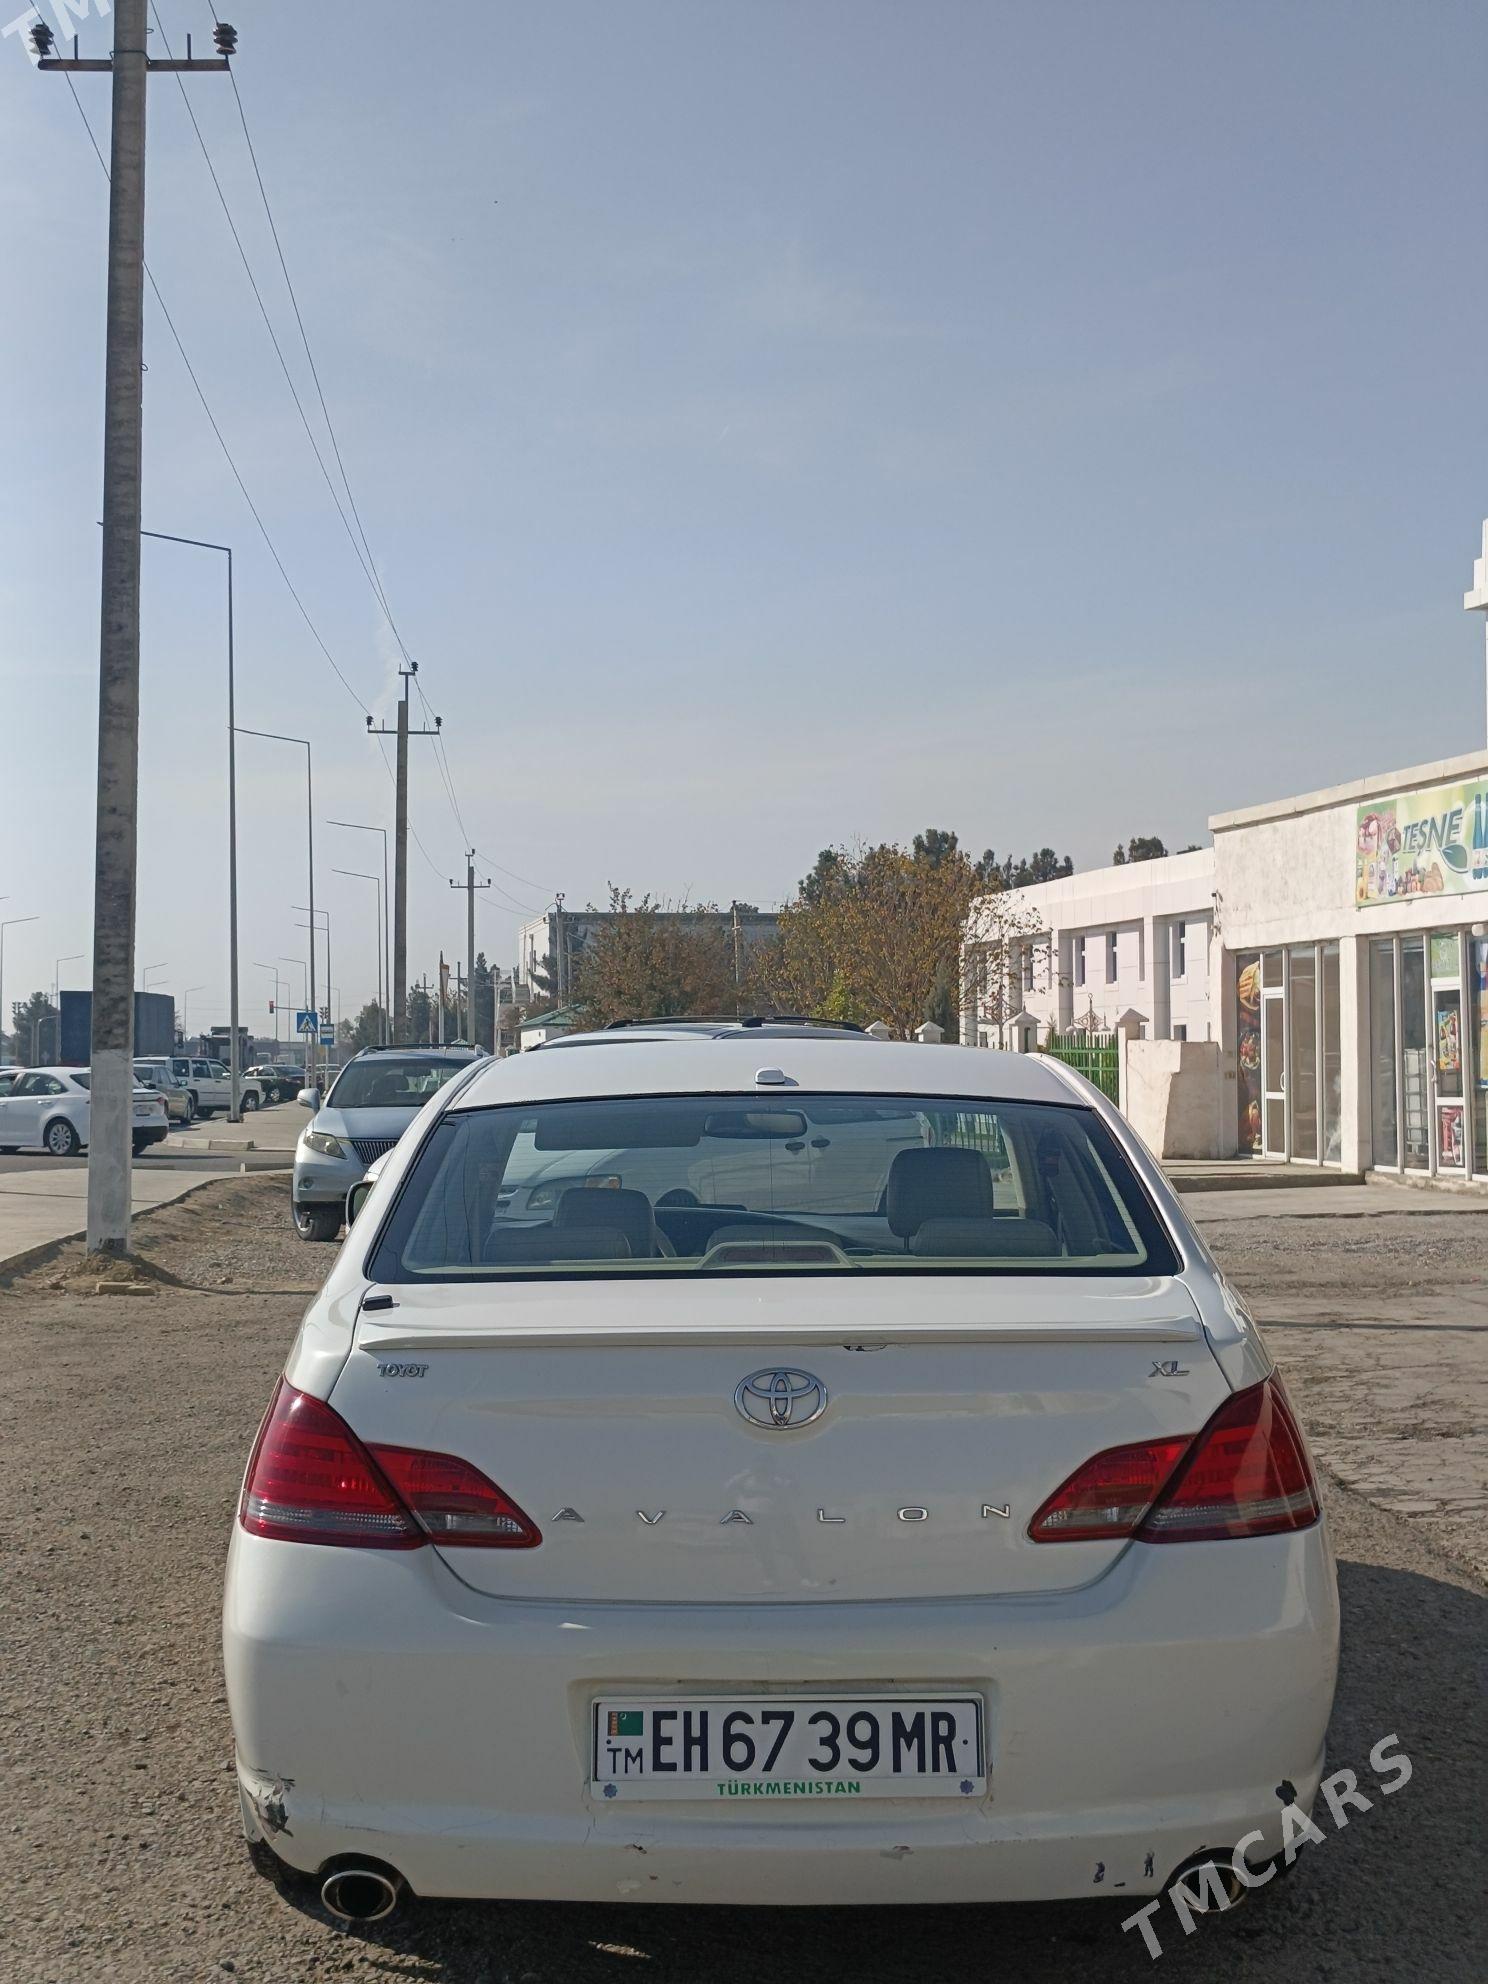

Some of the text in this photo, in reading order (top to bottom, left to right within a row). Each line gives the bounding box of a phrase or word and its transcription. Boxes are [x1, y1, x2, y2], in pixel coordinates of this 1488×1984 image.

[376, 1363, 430, 1378] TOYOT
[551, 1502, 1011, 1526] AVALON
[606, 1747, 643, 1774] TM
[717, 1779, 861, 1796] TÜRKMENISTAN
